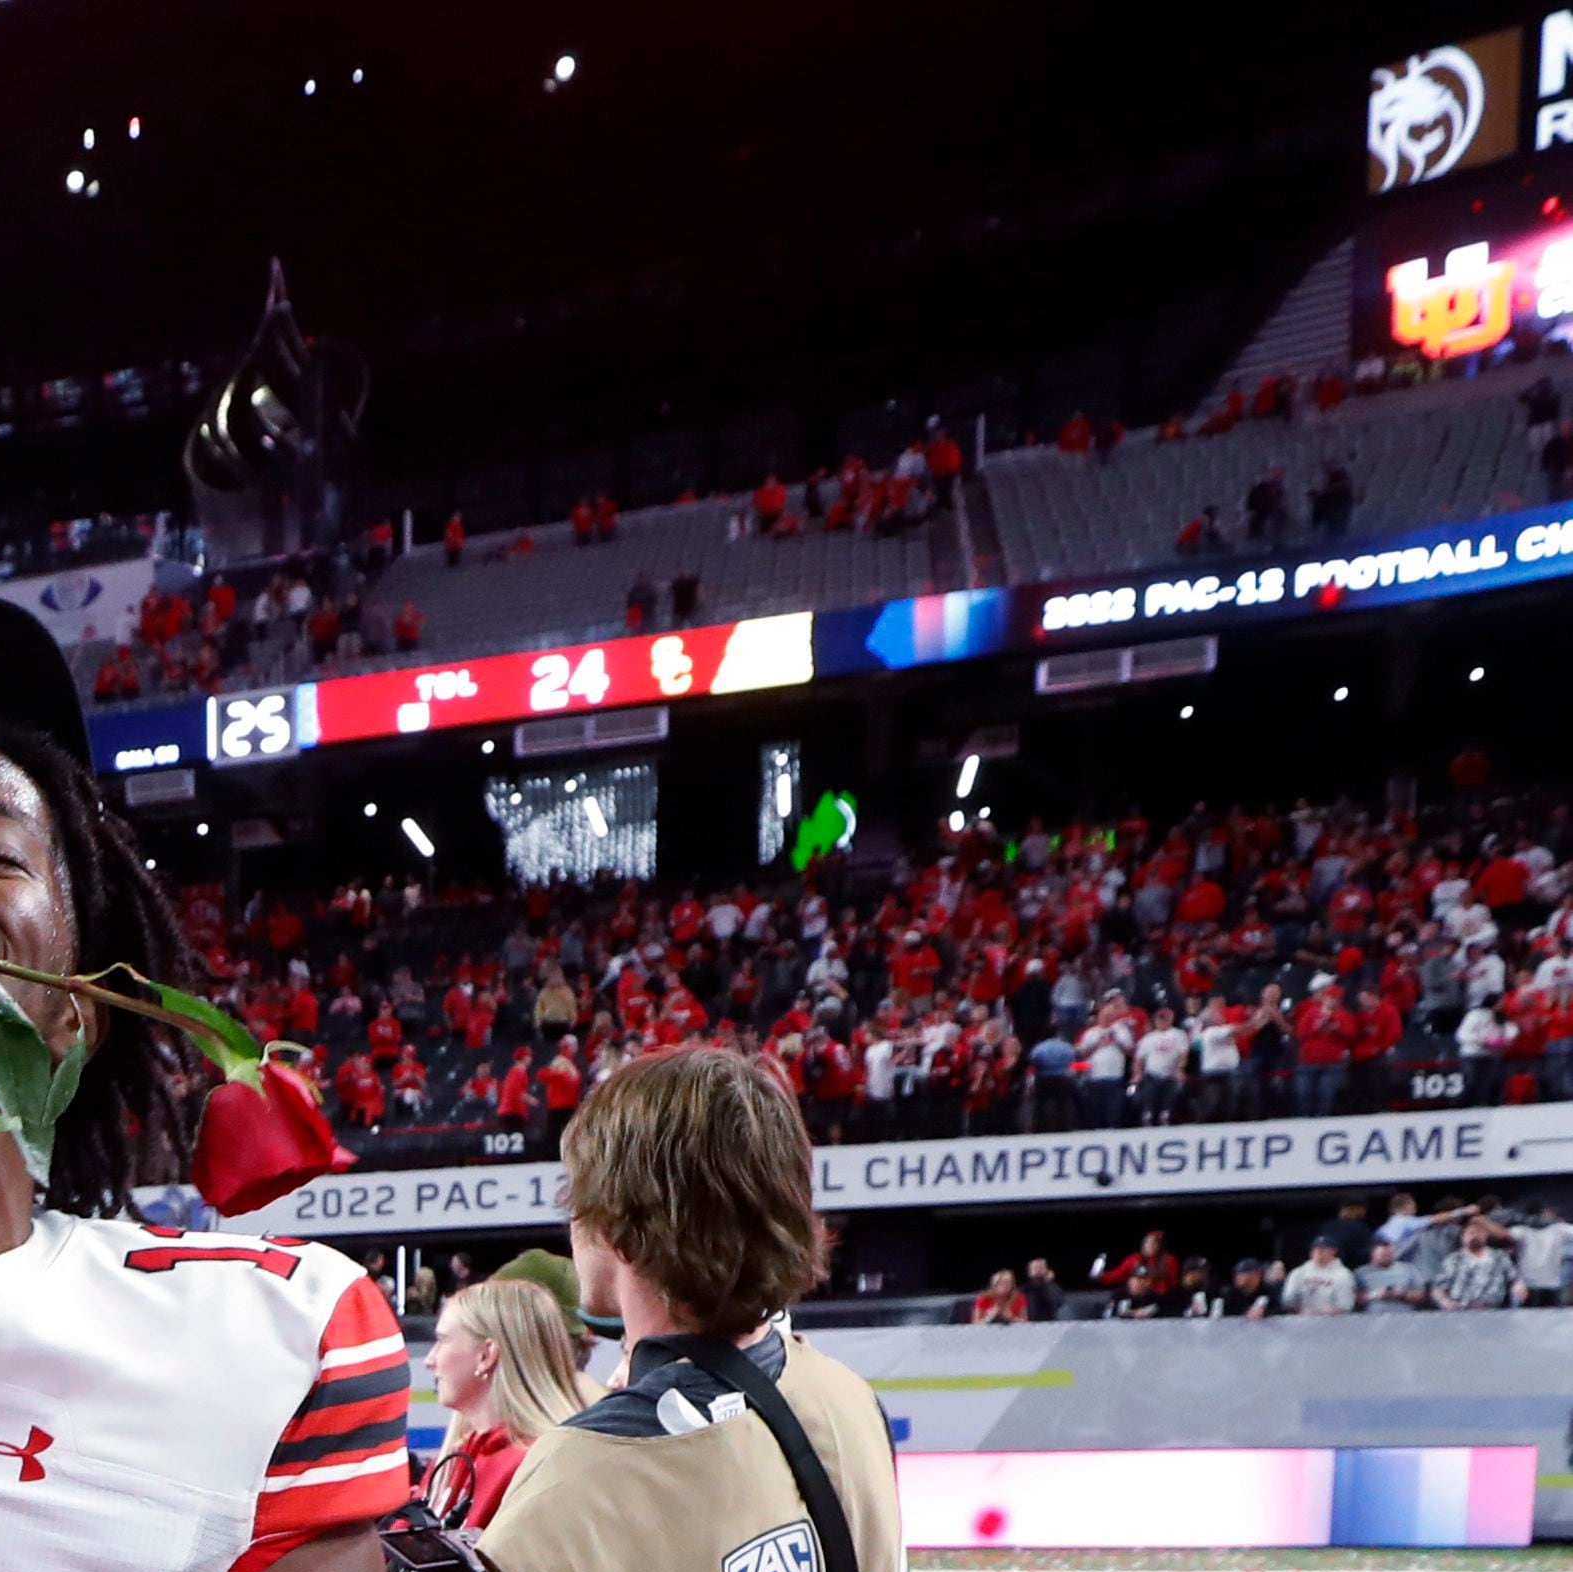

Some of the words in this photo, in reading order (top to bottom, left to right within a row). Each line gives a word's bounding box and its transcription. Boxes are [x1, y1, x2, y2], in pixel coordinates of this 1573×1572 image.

[1043, 589, 1137, 631] 2022
[1294, 534, 1508, 598] FOOTBALL
[530, 653, 611, 712] 24
[221, 694, 291, 758] 25
[1411, 1073, 1466, 1100] 103
[296, 1184, 396, 1220] 2022
[864, 1133, 1293, 1192] CHAMPIONSHIP
[1317, 1122, 1485, 1167] GAME
[483, 1131, 525, 1156] 102
